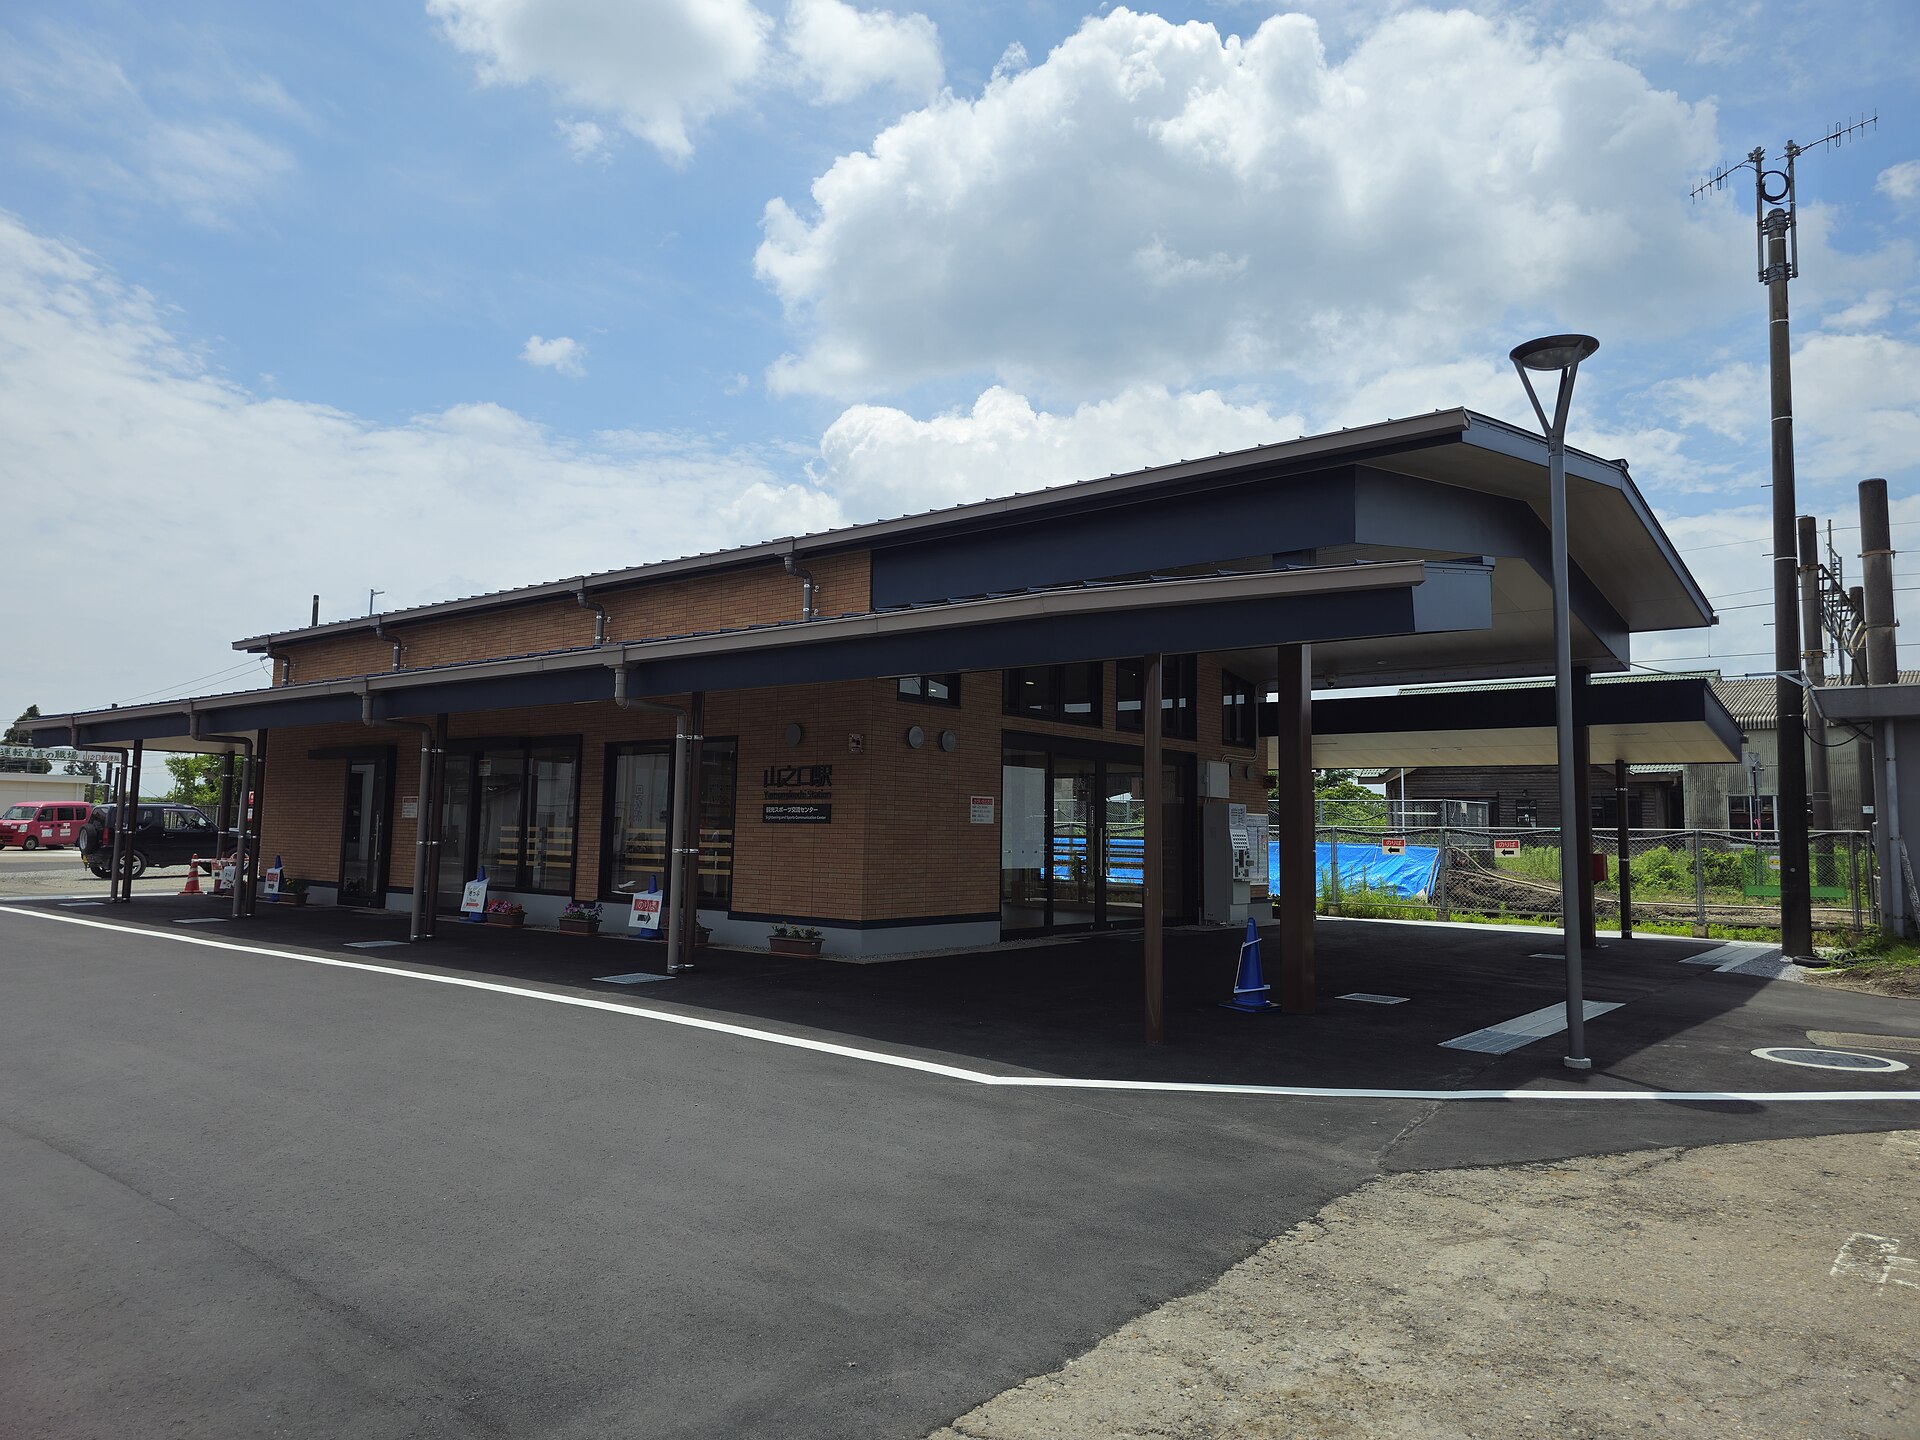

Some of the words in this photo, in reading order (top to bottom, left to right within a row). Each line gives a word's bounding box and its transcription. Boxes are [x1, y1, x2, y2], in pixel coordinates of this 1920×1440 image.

[764, 765, 832, 787] 山之口駅
[807, 790, 831, 800] Station
[638, 901, 657, 910] のりば
